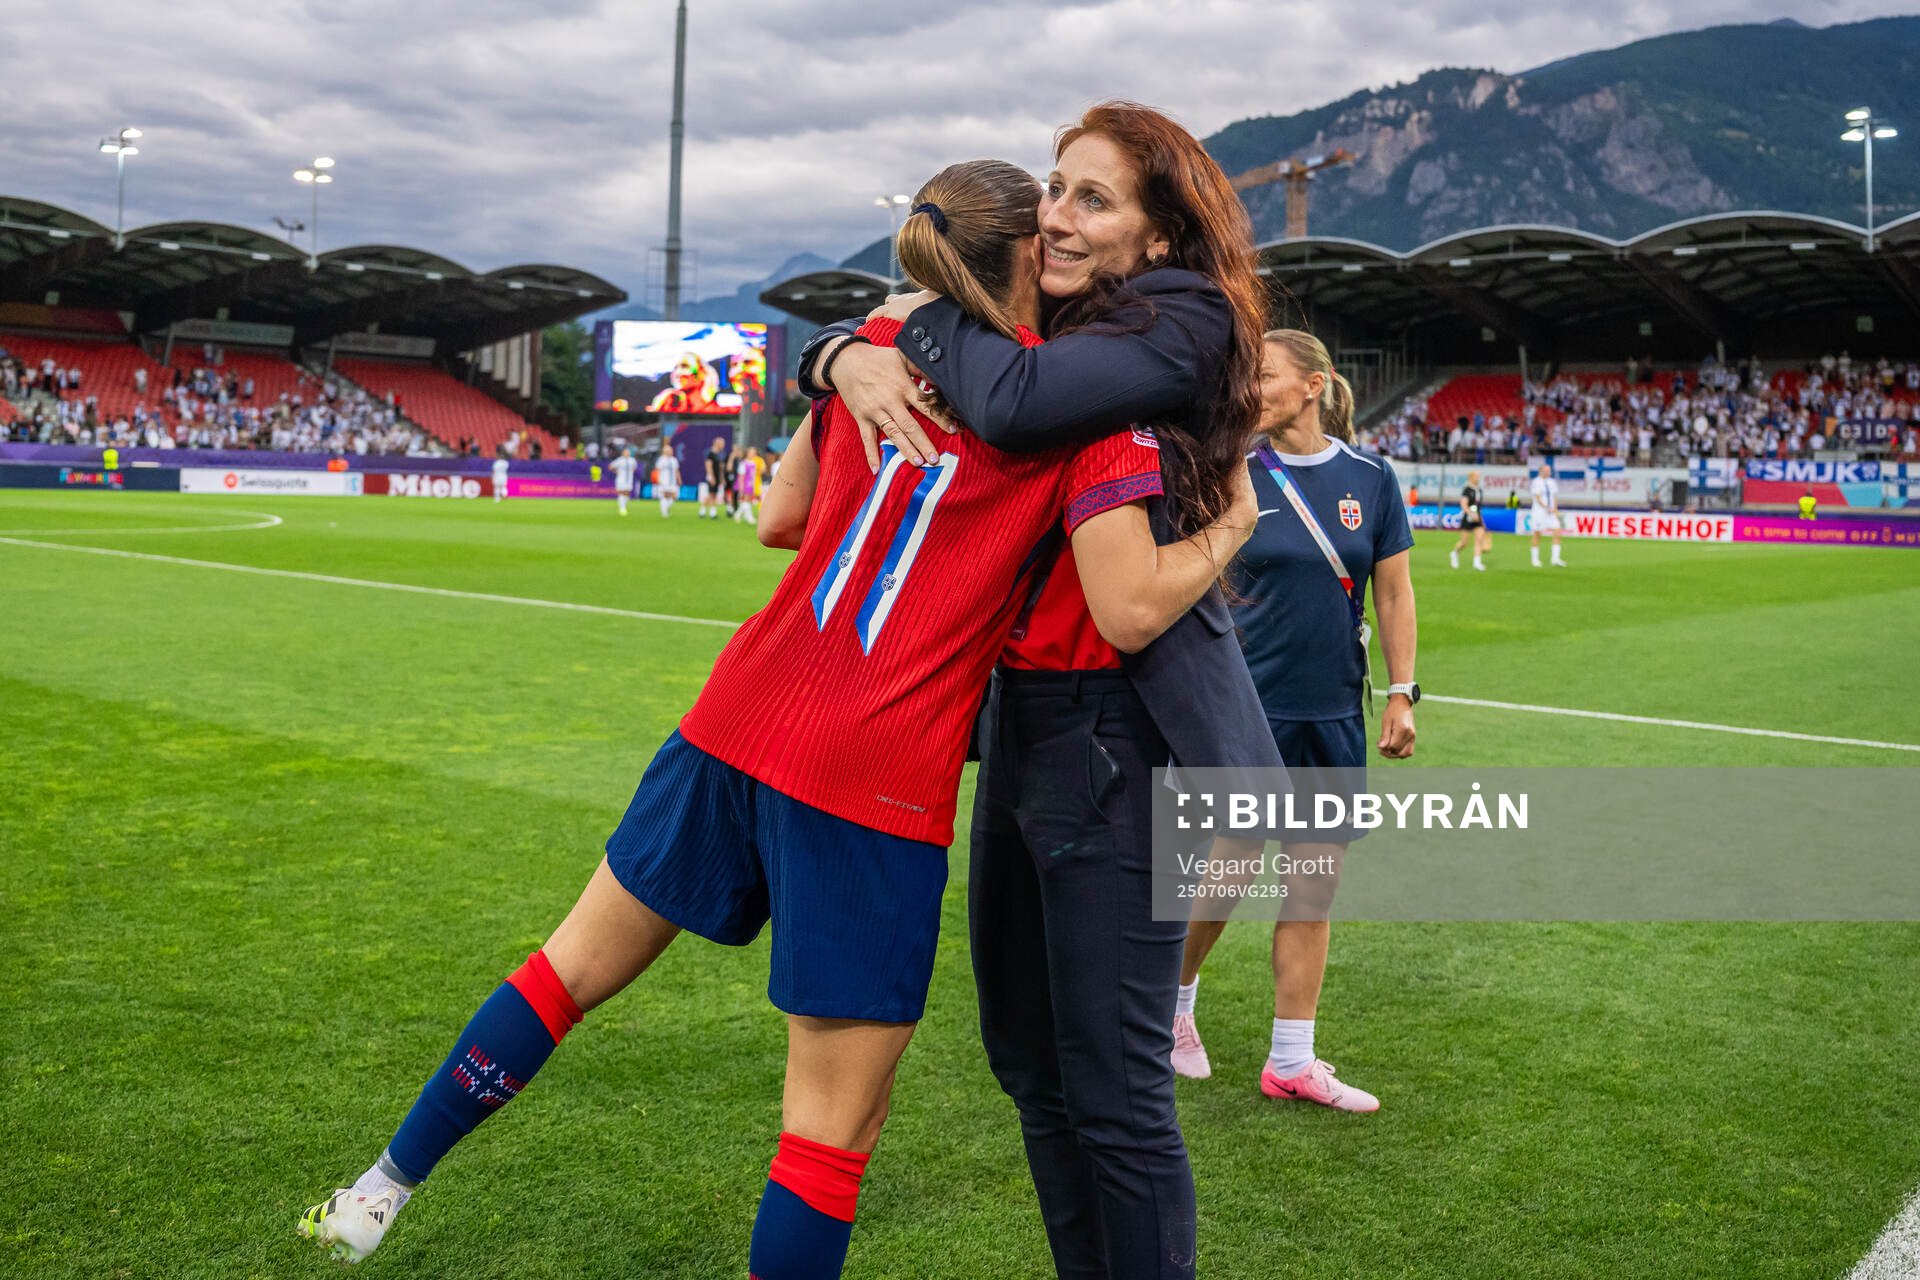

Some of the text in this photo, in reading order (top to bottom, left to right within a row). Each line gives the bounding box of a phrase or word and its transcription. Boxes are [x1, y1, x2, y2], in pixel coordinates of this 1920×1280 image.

[1764, 460, 1860, 482] SMJK
[388, 473, 481, 498] Miele
[1576, 516, 1729, 539] WIESENHOF
